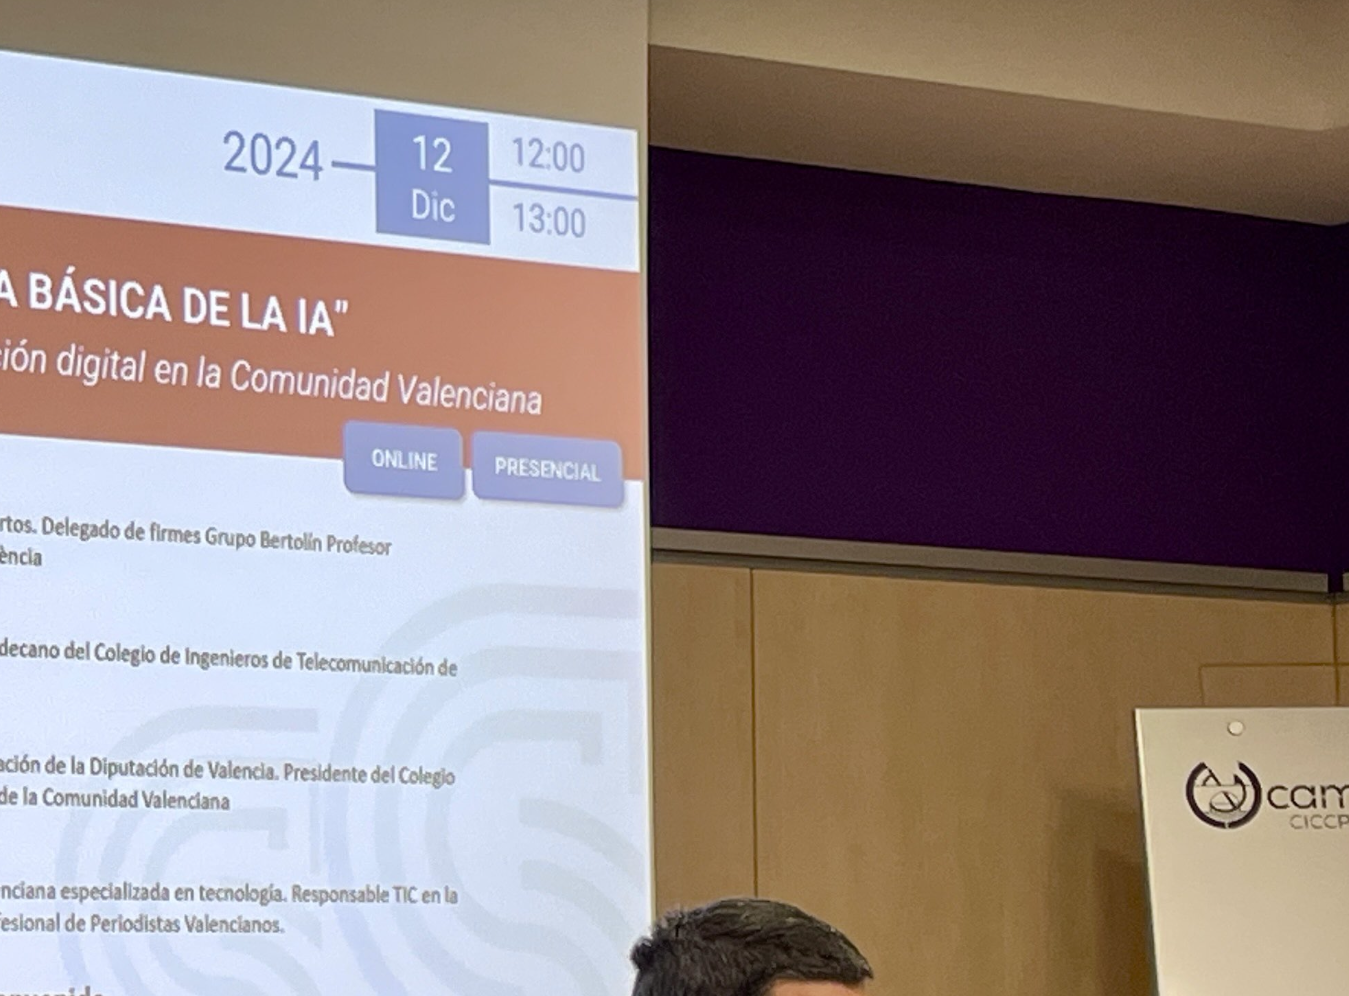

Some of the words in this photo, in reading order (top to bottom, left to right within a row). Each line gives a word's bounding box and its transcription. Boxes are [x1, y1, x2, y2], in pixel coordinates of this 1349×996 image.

[223, 130, 323, 181] 2024
[413, 135, 452, 172] 12
[513, 137, 585, 173] 12:00
[413, 189, 455, 222] Dic
[513, 203, 586, 238] 13:00
[30, 266, 172, 321] BÁSICA
[184, 287, 230, 327] DE
[242, 293, 287, 332] LA
[299, 298, 348, 336] IA”
[57, 343, 146, 386] digital
[155, 360, 188, 385] en
[197, 355, 221, 388] la
[231, 360, 390, 402] Comunidad
[398, 374, 542, 415] Valenciana
[372, 449, 437, 471] ONLINE
[496, 457, 601, 482] PRESENCIAL
[42, 516, 120, 541] Delegado
[124, 521, 145, 541] de
[150, 522, 201, 544] firmes
[205, 527, 256, 551] Grupo
[260, 531, 322, 552] Bertolín
[327, 535, 392, 555] Profesor
[64, 640, 90, 660] del
[94, 642, 156, 667] Colegio
[160, 645, 180, 664] de
[185, 647, 268, 670] Ingenieros
[273, 650, 292, 669] de
[296, 652, 434, 675] Telecomunicación
[438, 658, 458, 677] de
[45, 755, 66, 774] de
[71, 755, 85, 775] la
[90, 757, 179, 780] Diputación
[183, 759, 204, 778] de
[207, 760, 279, 780] Valencia.
[284, 763, 367, 783] Presidente
[371, 765, 395, 784] del
[399, 766, 455, 789] Colegio
[23, 786, 37, 805] la
[43, 788, 138, 808] Comunidad
[142, 790, 230, 810] Valenciana
[60, 881, 169, 904] especializada
[175, 887, 194, 901] en
[199, 883, 287, 906] tecnología.
[292, 884, 389, 907] Responsable
[392, 885, 418, 904] TIC
[422, 890, 441, 904] en
[444, 885, 458, 904] la
[64, 912, 86, 932] de
[91, 913, 180, 933] Periodistas
[184, 914, 285, 933] Valencianos.
